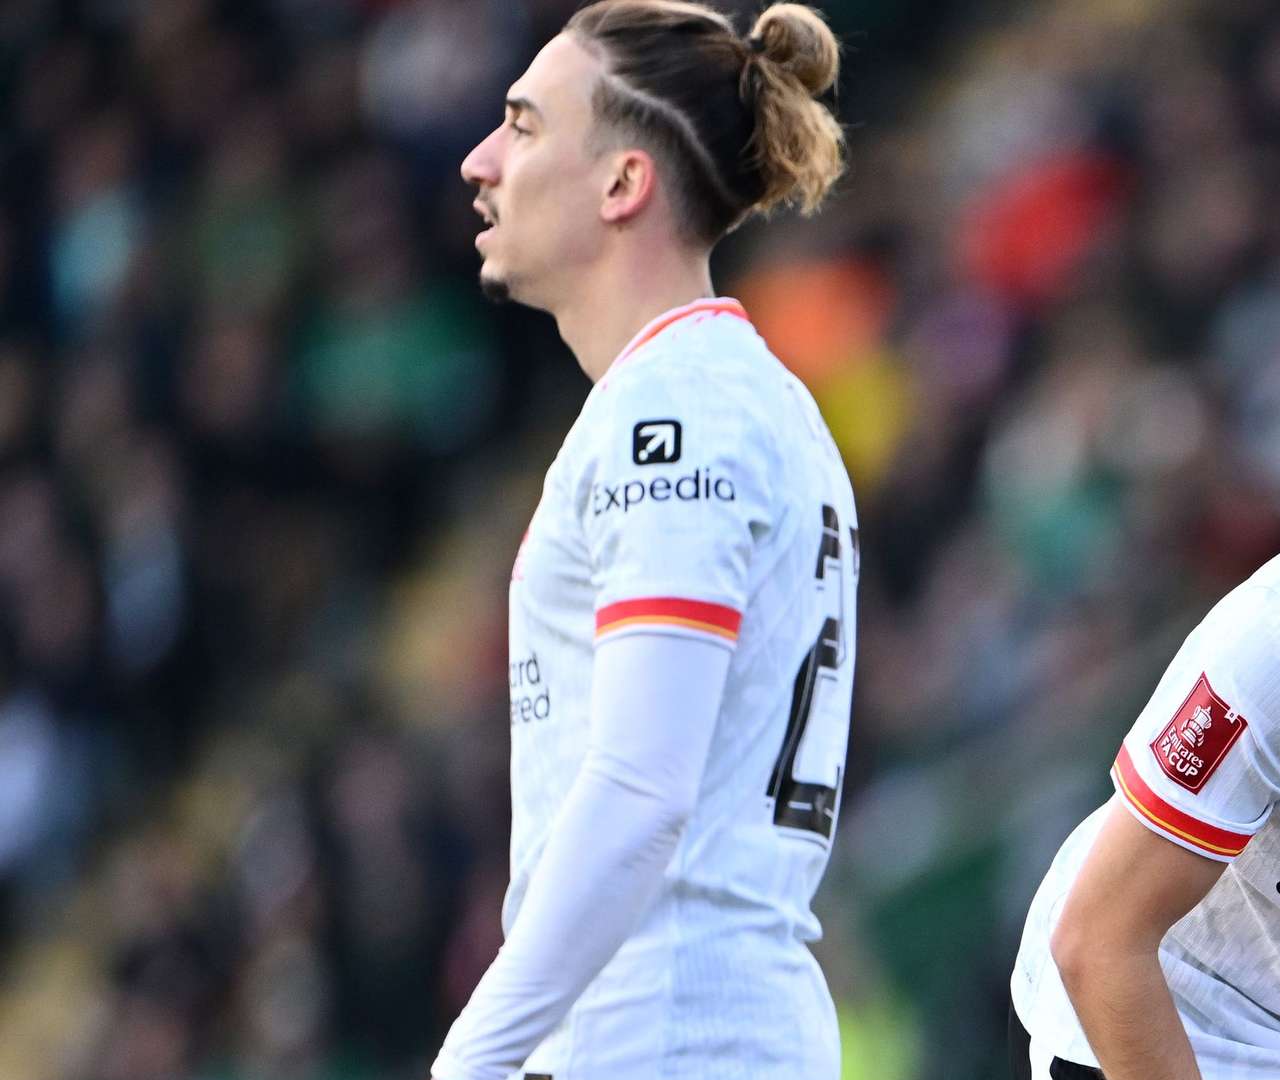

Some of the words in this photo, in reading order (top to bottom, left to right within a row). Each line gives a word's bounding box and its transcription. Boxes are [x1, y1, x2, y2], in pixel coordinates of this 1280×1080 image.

[764, 503, 860, 842] 2
[1168, 726, 1204, 768] Emirates
[1168, 751, 1199, 776] CUP
